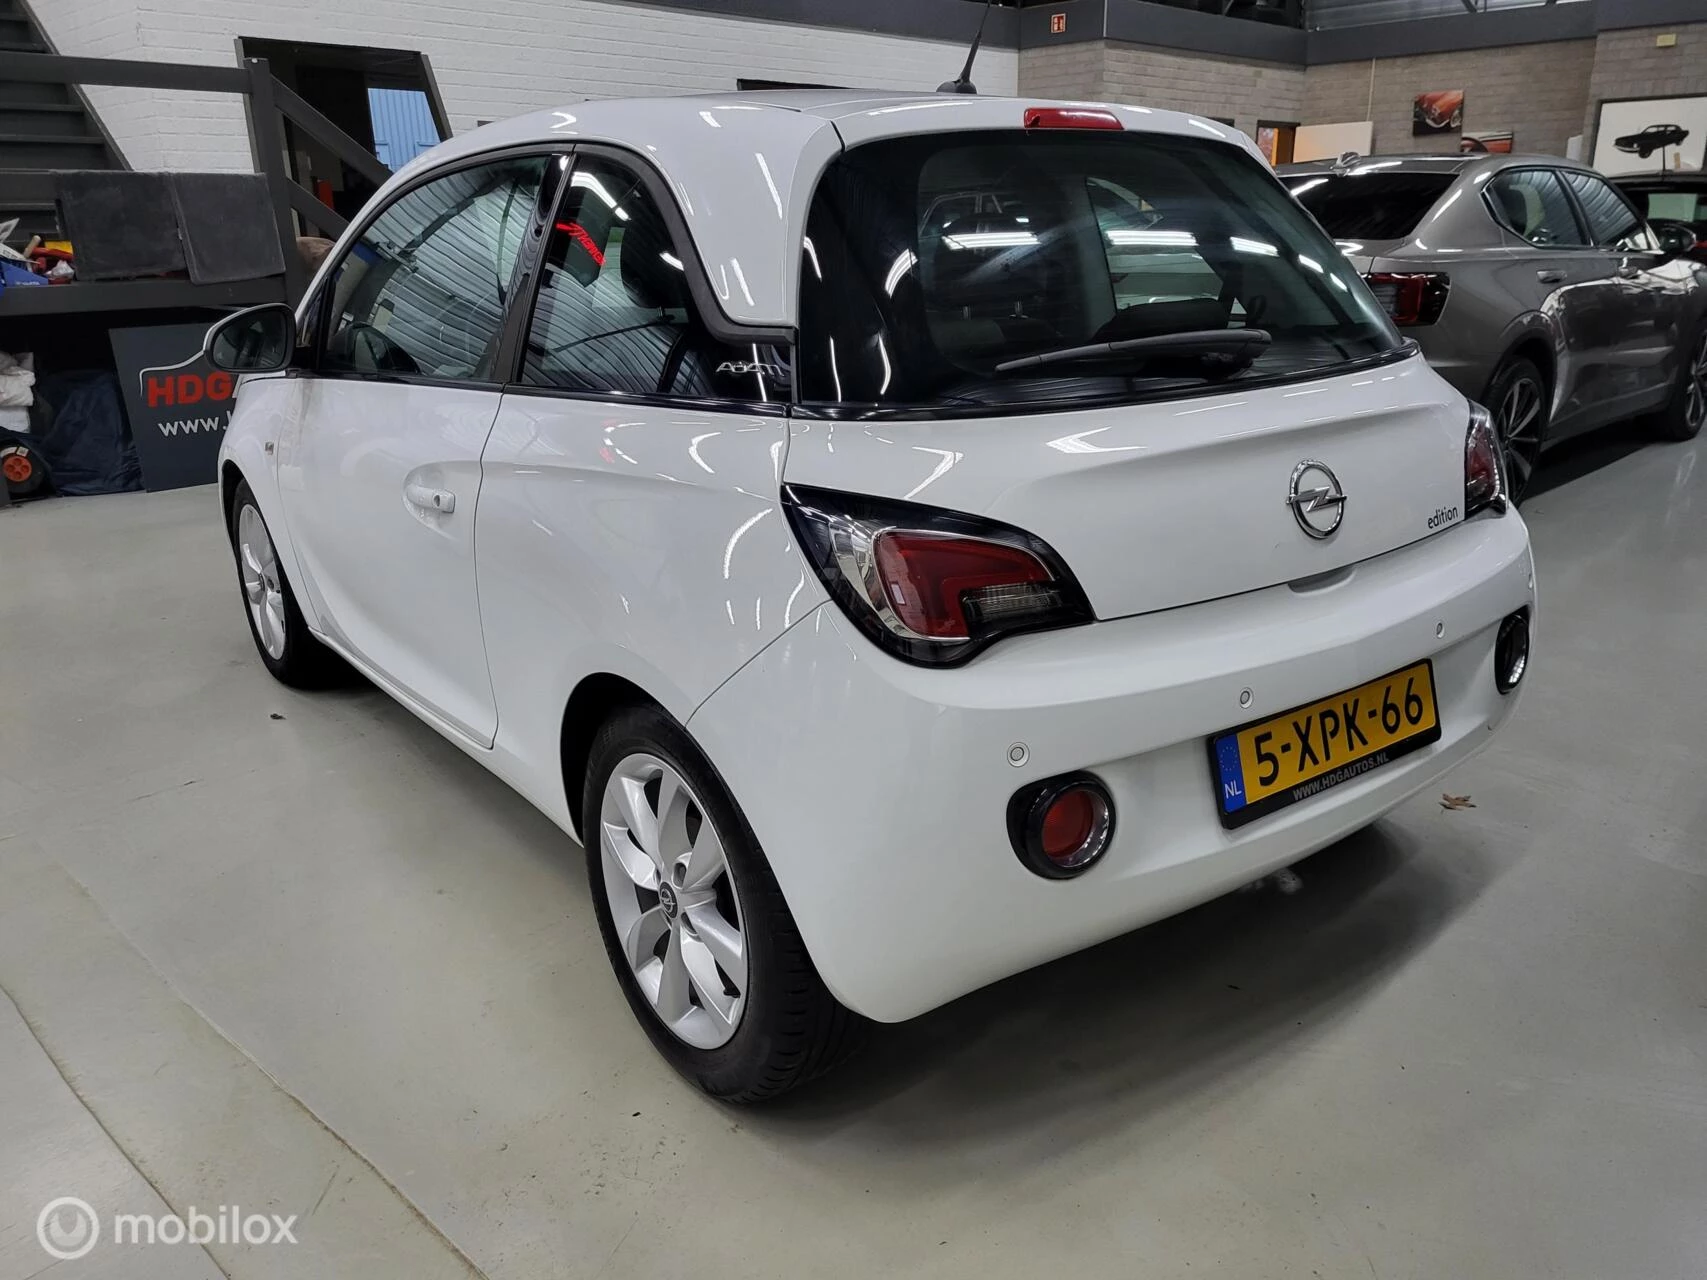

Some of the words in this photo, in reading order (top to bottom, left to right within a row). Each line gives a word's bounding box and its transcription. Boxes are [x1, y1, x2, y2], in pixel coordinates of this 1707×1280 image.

[147, 370, 233, 408] HDG
[1427, 506, 1459, 529] edition
[1253, 676, 1424, 787] 5-XPK-66
[1224, 780, 1242, 800] NL
[1292, 751, 1390, 802] WWW.HDGAUTOS.NL
